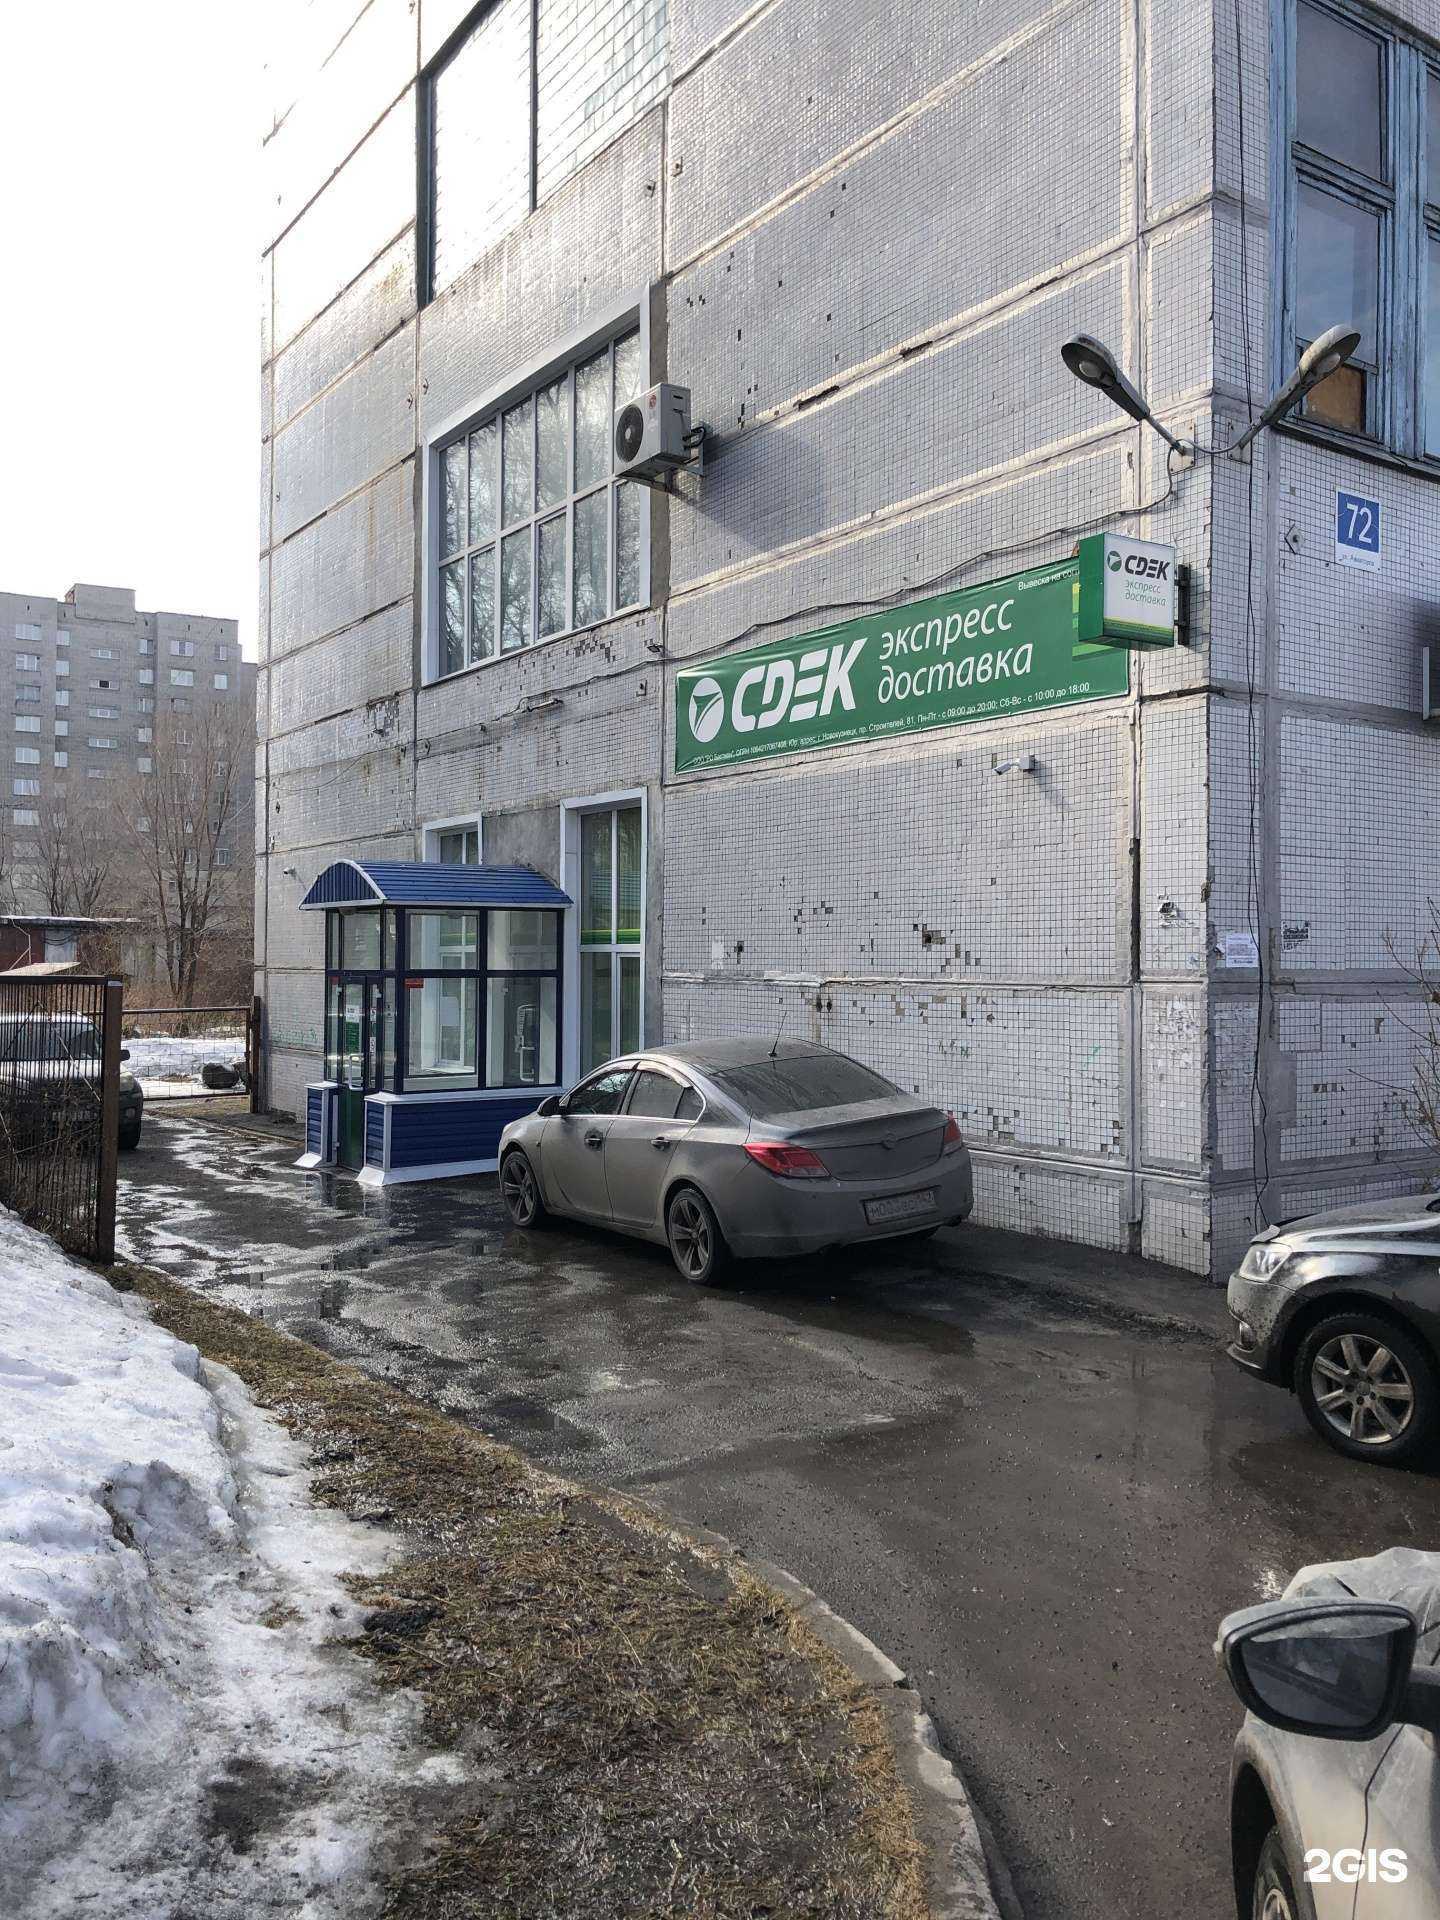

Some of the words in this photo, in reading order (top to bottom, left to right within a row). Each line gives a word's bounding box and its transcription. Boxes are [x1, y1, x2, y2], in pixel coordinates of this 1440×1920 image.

[1347, 502, 1372, 543] 72
[1125, 554, 1171, 581] CDEK
[1018, 575, 1050, 591] Вывеска
[1125, 580, 1161, 594] экспресс
[1125, 590, 1166, 606] доставка
[879, 599, 1015, 660] экспресс
[731, 637, 869, 733] CDEK
[878, 643, 1034, 704] доставка
[999, 696, 1022, 708] Сб-Вс
[1034, 689, 1056, 701] 10:00
[1056, 688, 1067, 699] до
[1068, 682, 1090, 694] 18:00
